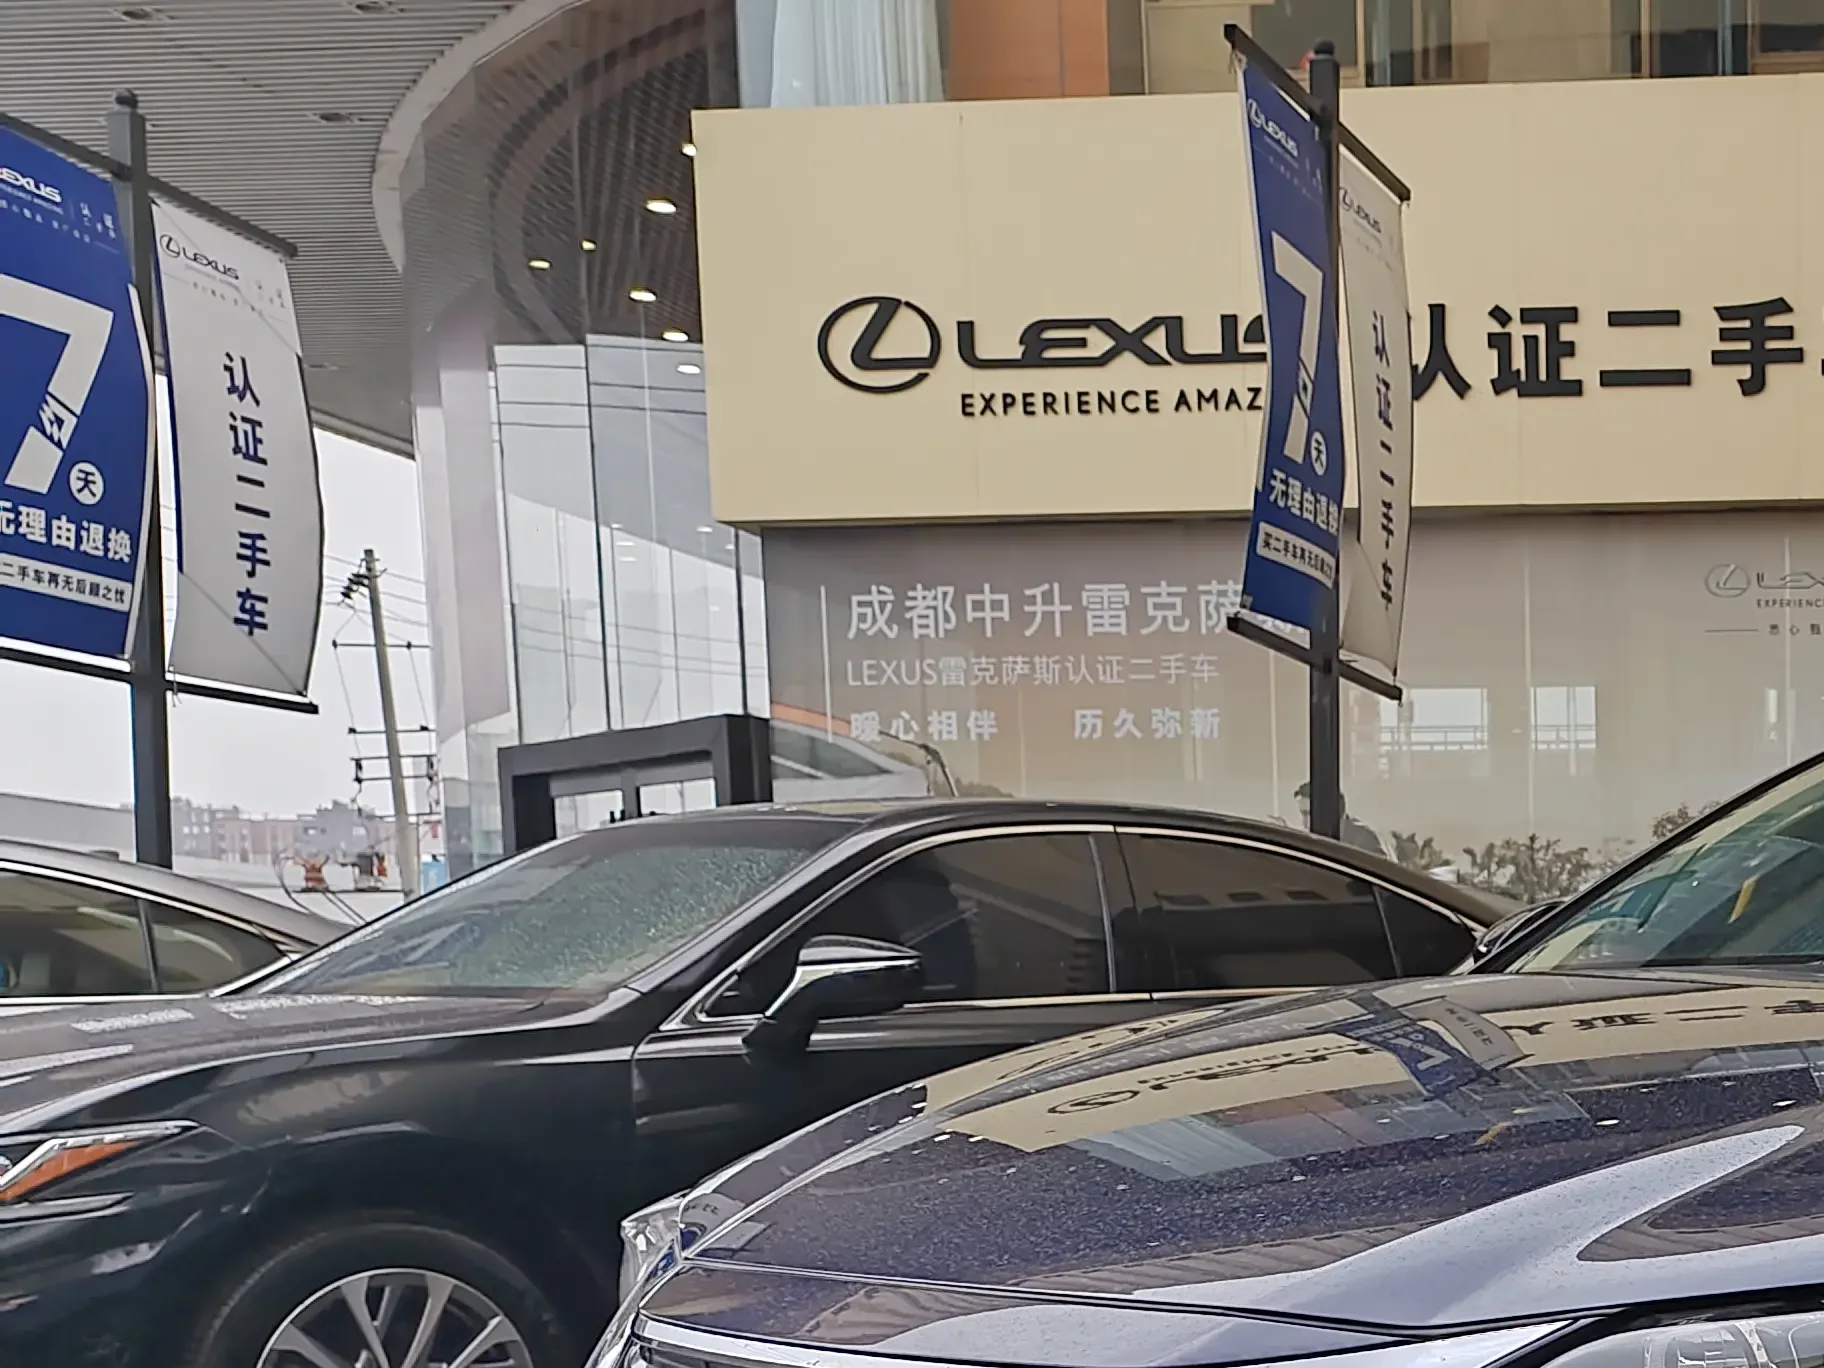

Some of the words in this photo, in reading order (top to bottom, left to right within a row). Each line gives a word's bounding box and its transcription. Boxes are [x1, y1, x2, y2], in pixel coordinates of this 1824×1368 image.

[0, 167, 62, 203] EXUS
[182, 247, 239, 280] LEXUS
[961, 390, 1160, 417] EXPERIENCE
[1174, 387, 1263, 413] AMAZ
[76, 469, 97, 498] 天
[223, 352, 271, 636] 认证二手车
[0, 562, 125, 604] 二手车再无后顾之忧
[1074, 707, 1220, 739] 历久弥新
